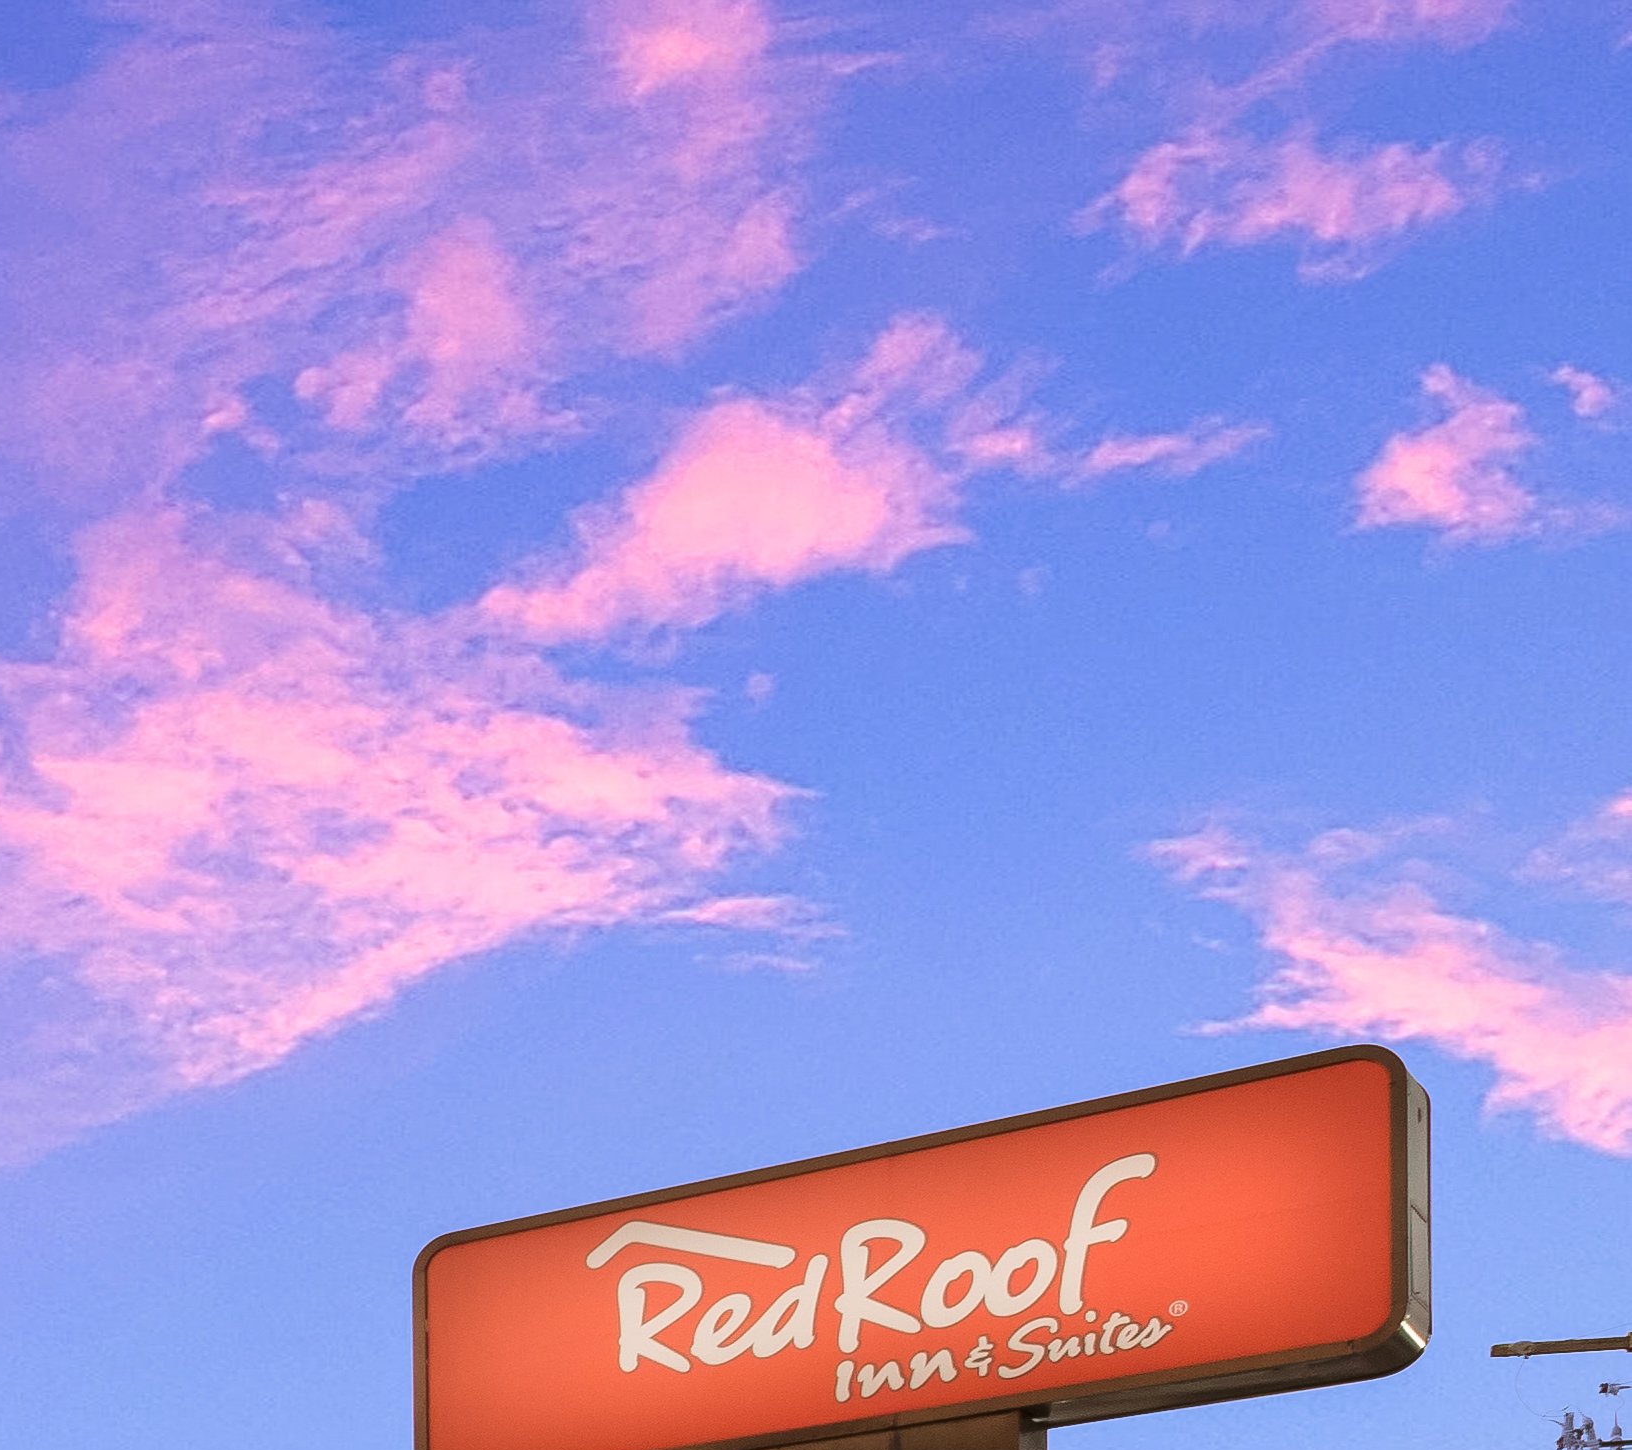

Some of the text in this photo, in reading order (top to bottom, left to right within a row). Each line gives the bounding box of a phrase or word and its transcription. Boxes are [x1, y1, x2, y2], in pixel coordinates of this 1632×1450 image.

[834, 1310, 1173, 1402] Inn & Suites
